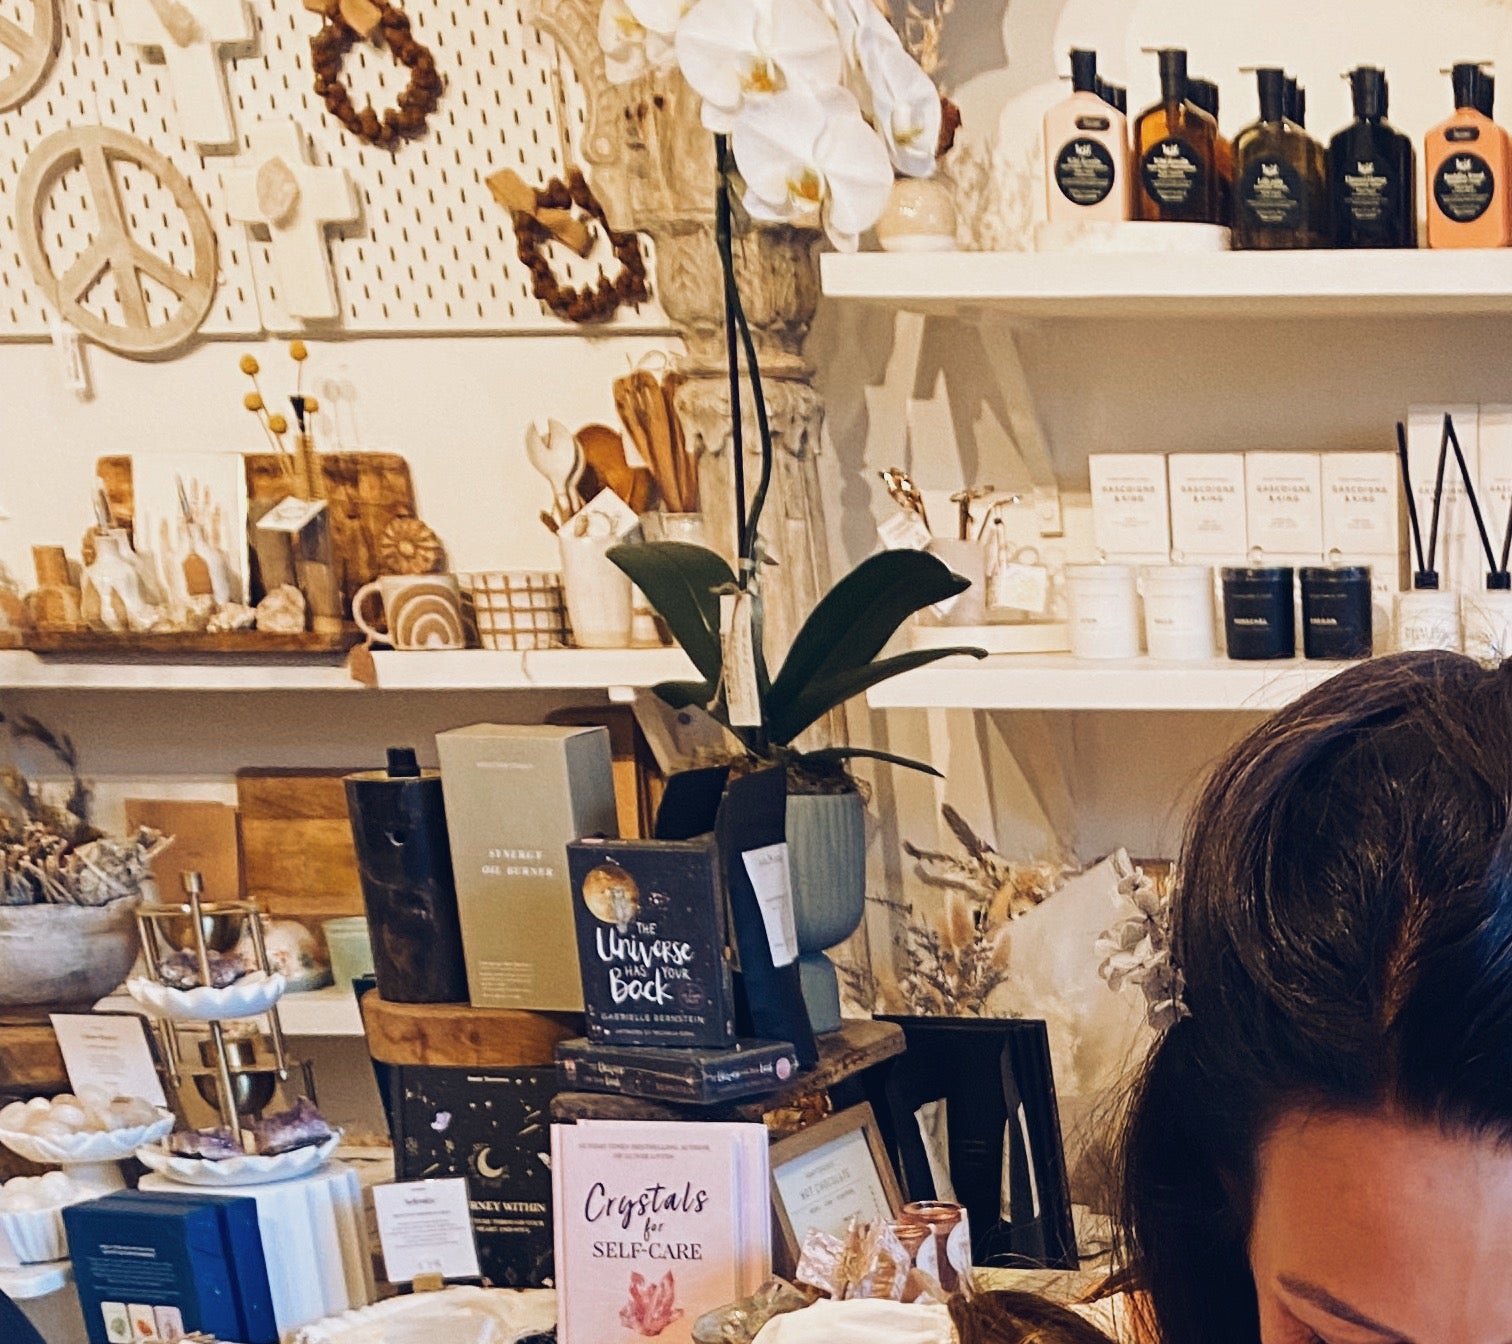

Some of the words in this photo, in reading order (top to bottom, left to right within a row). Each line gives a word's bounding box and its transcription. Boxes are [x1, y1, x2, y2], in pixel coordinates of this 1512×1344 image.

[636, 921, 657, 935] THE
[624, 965, 647, 978] HAS
[661, 967, 691, 980] YOUR
[609, 967, 673, 1005] Back
[585, 1181, 710, 1229] Crystals
[643, 1217, 664, 1241] for
[593, 1241, 703, 1261] SELF-CARE
